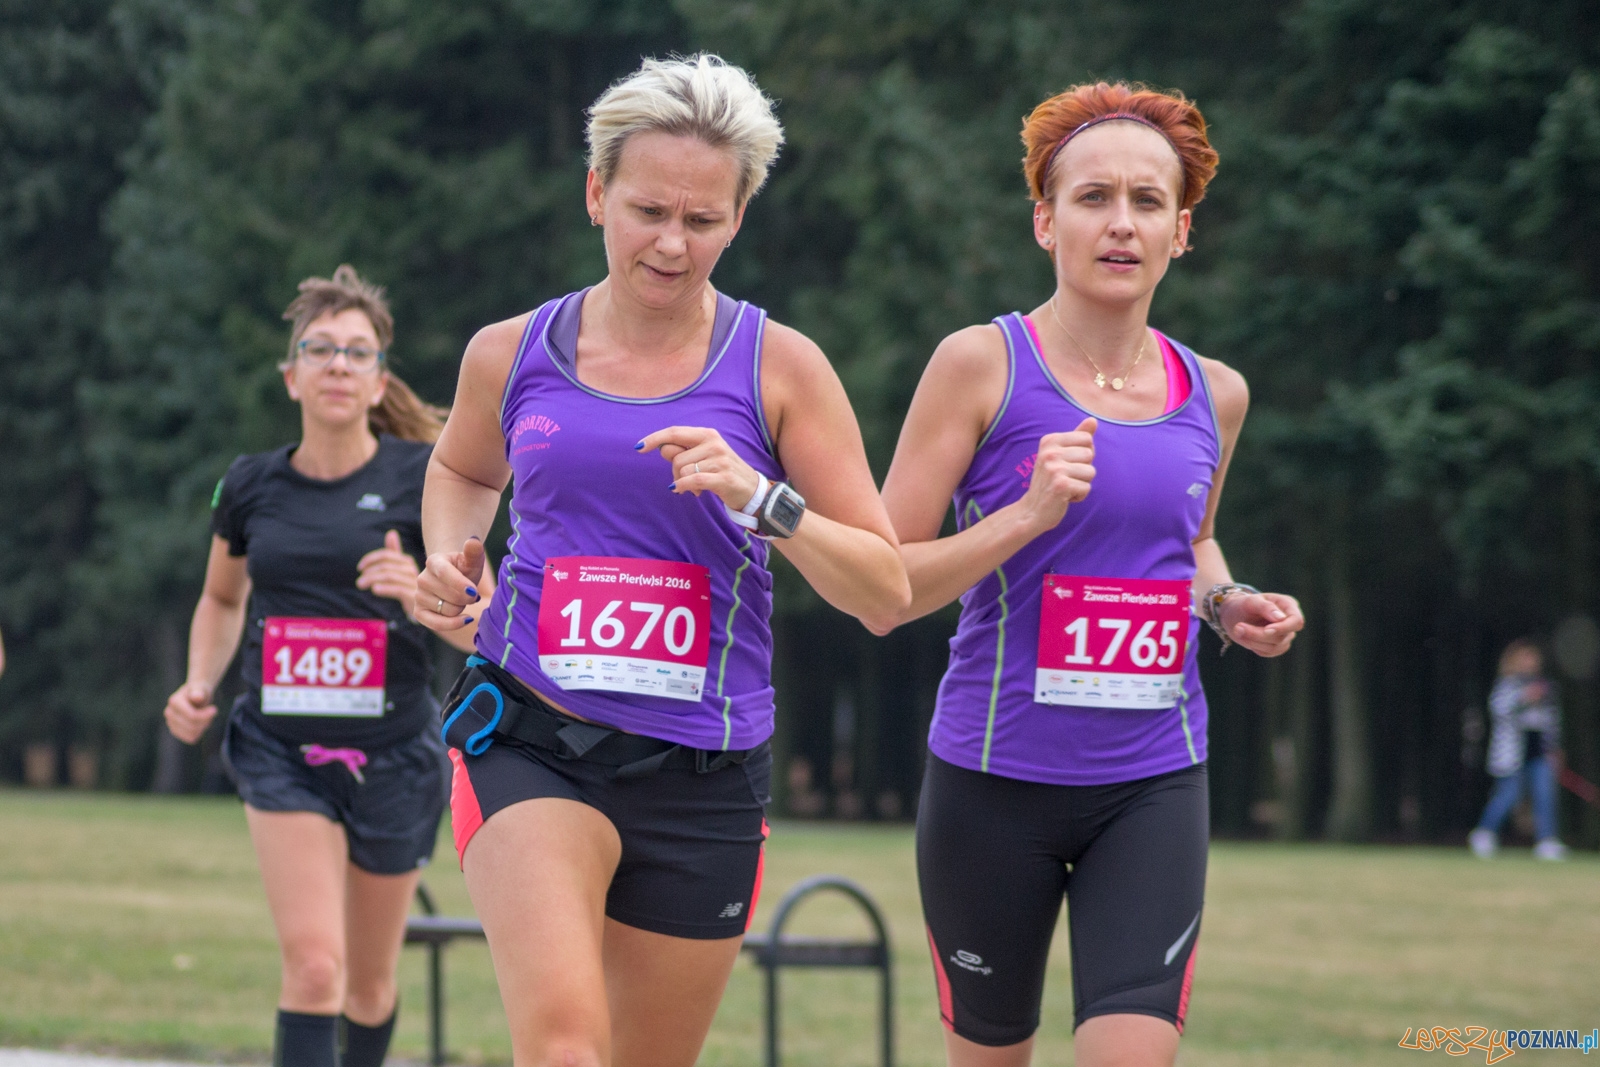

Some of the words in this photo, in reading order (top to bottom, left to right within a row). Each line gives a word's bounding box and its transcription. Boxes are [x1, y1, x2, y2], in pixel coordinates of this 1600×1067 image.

[579, 571, 617, 583] Zawsze
[619, 573, 663, 588] Pier(w)si
[664, 576, 691, 590] 2016
[560, 598, 696, 656] 1670
[1064, 617, 1180, 668] 1765
[274, 646, 372, 685] 1489
